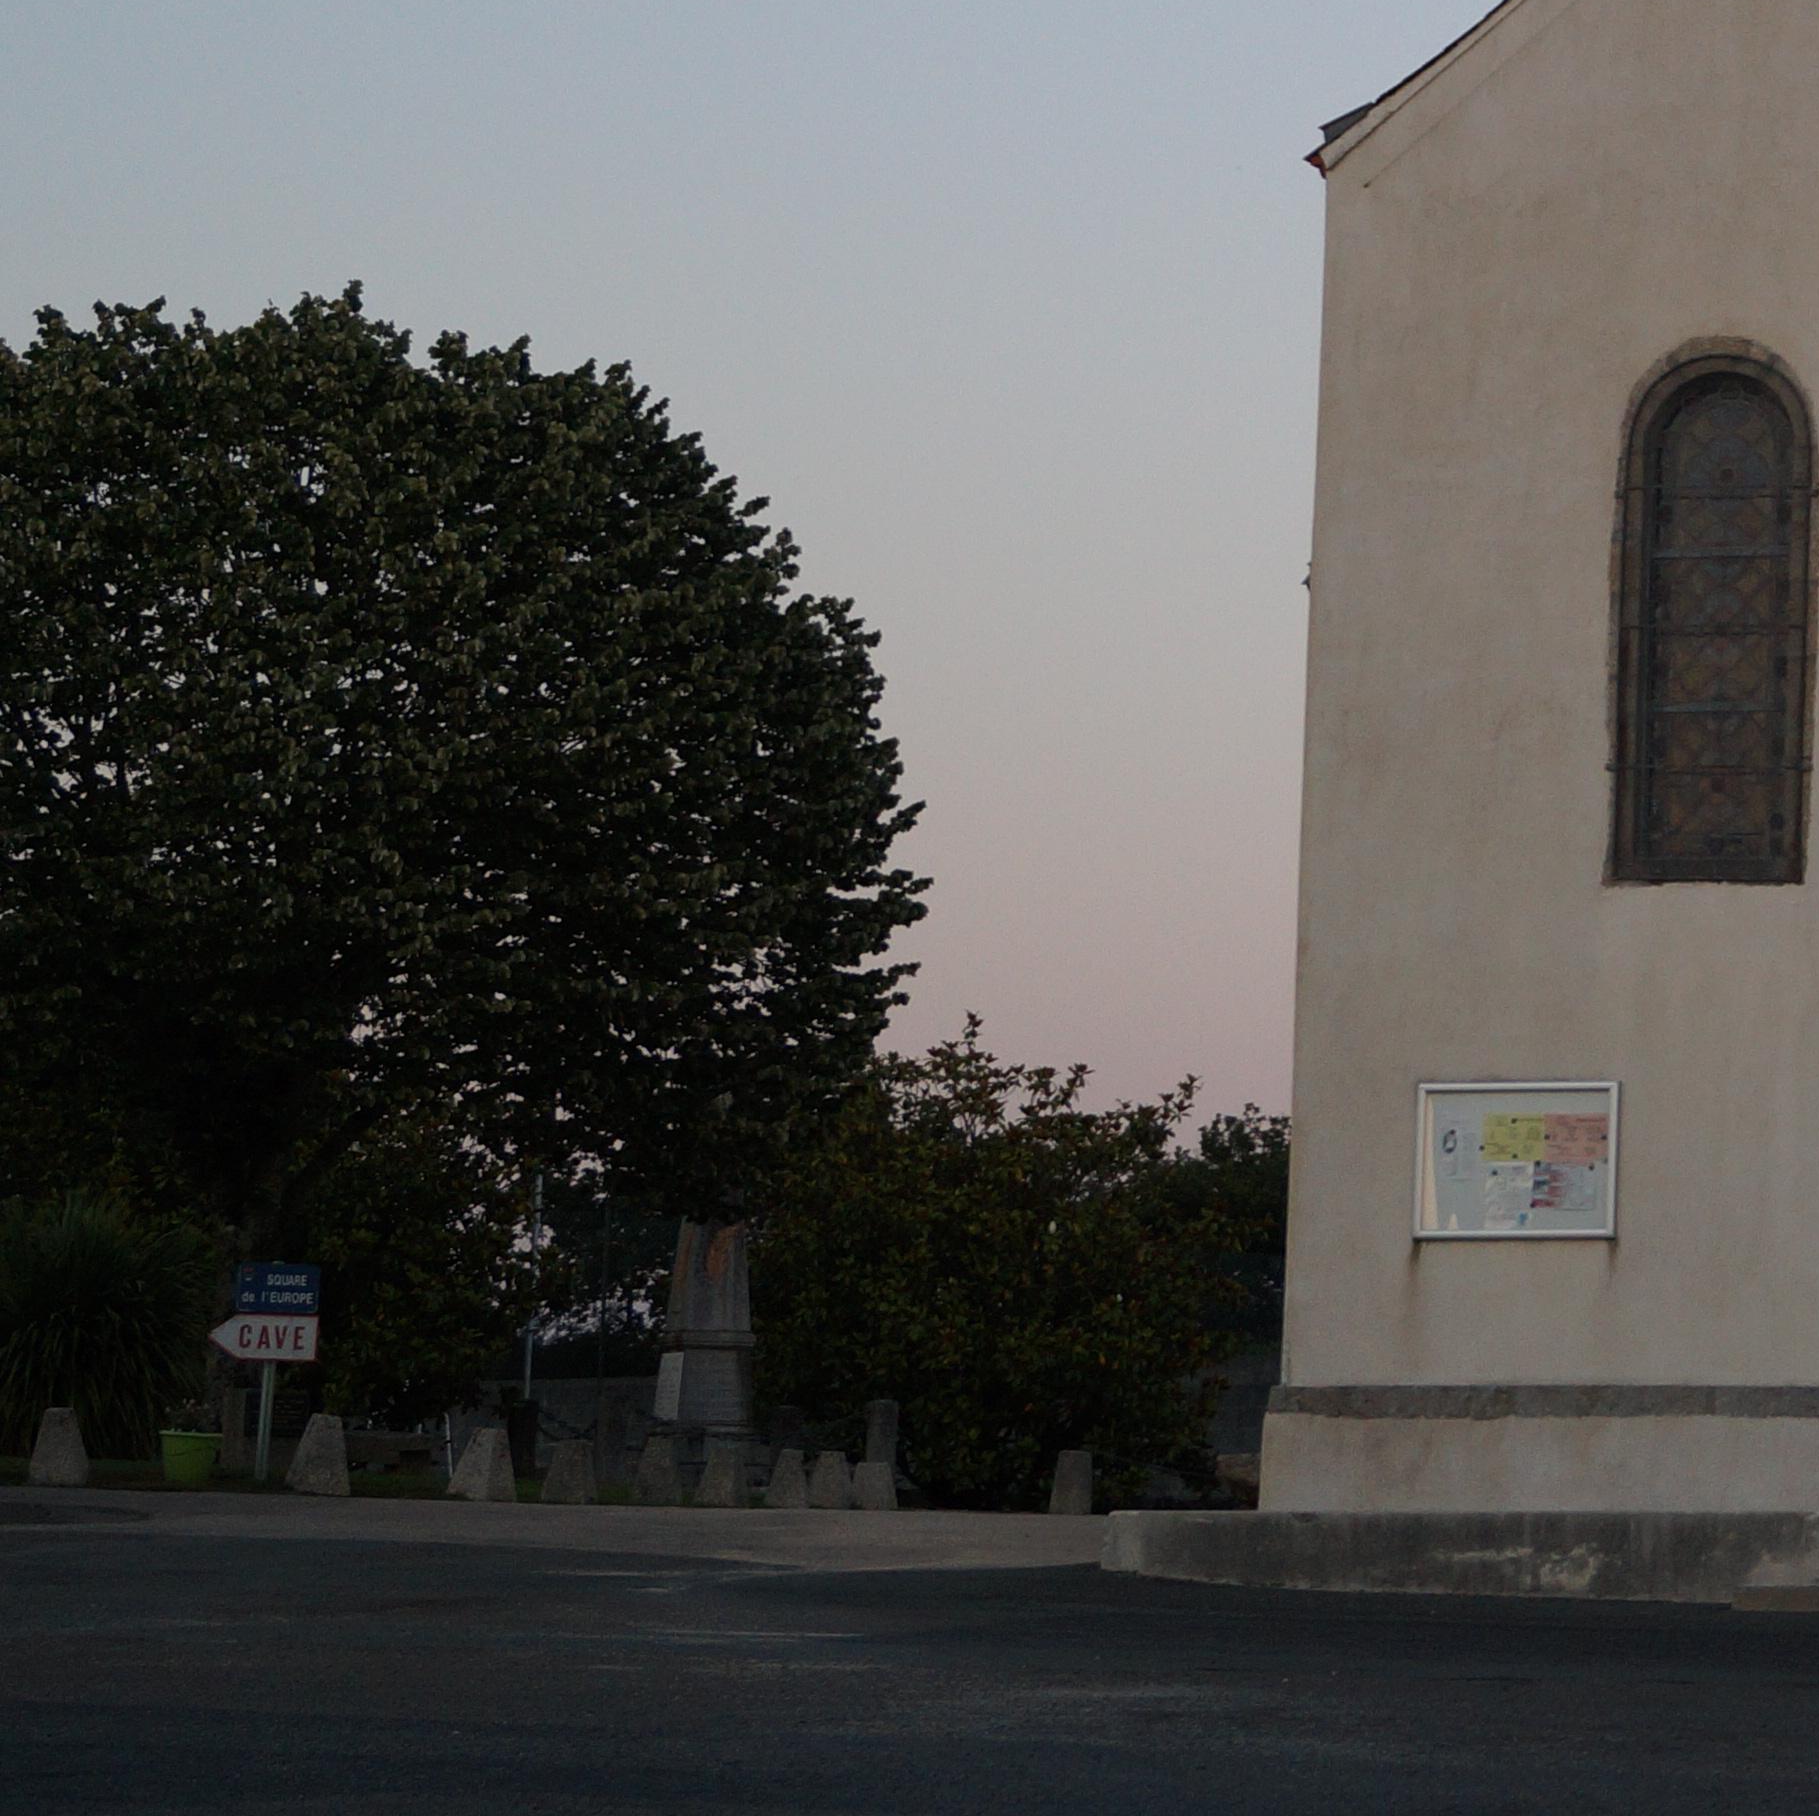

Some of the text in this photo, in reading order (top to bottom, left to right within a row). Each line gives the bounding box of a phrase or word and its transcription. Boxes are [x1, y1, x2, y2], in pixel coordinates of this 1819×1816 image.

[266, 1273, 308, 1286] SQUARE
[241, 1291, 315, 1304] de l'EUROPE
[240, 1324, 306, 1351] CAVE
